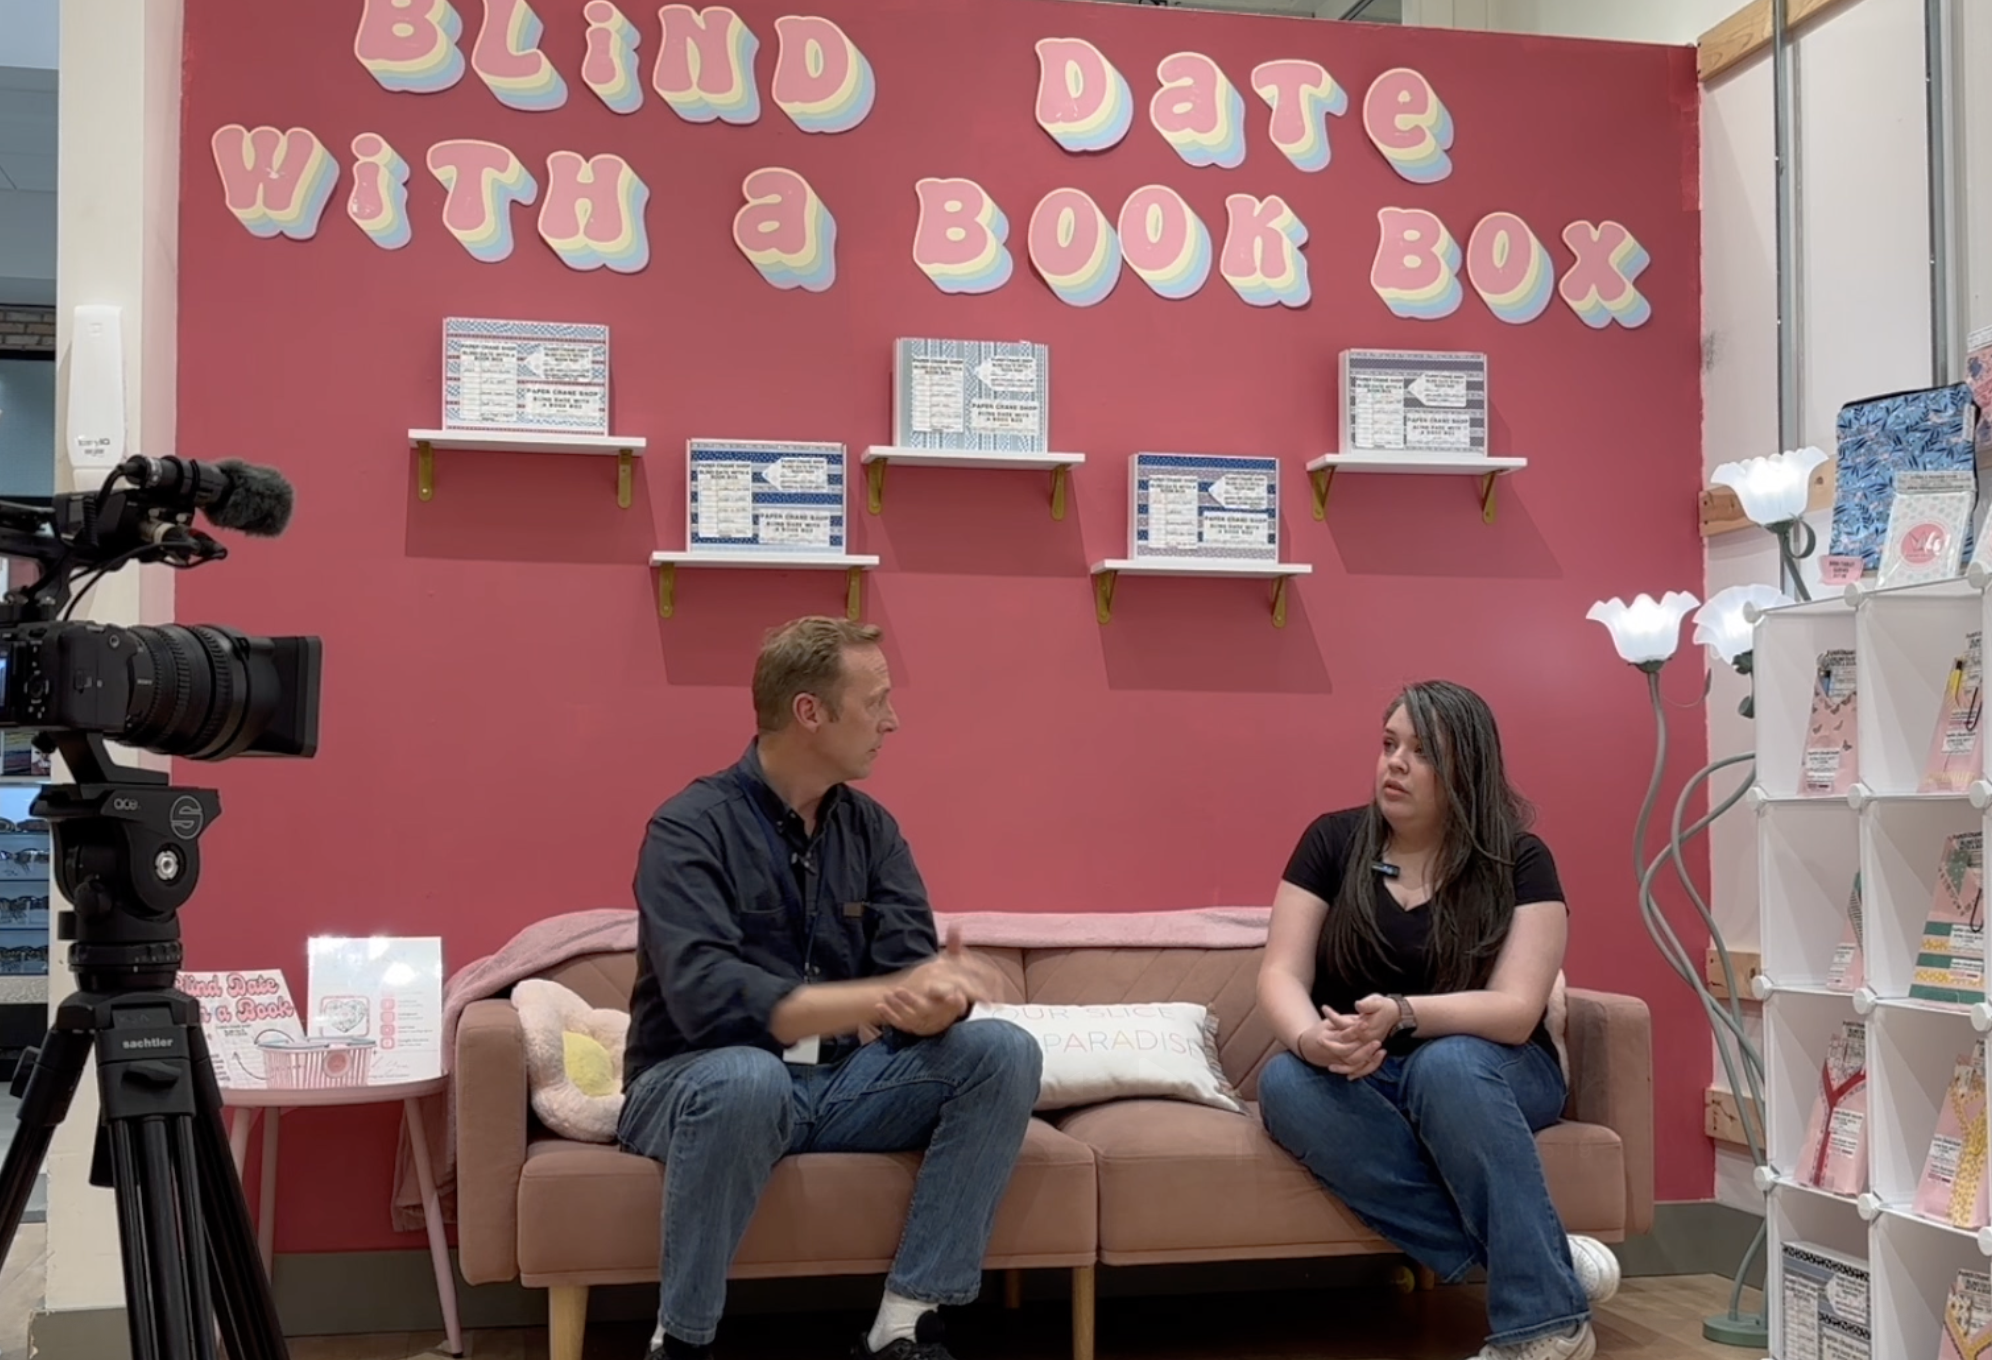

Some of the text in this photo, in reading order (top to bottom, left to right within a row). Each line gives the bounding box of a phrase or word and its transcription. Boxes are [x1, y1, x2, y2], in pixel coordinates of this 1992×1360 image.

[913, 177, 1312, 308] BOOK
[1370, 206, 1651, 329] BOX
[226, 972, 280, 998] Date
[215, 1005, 232, 1023] a
[235, 997, 294, 1023] Book
[1086, 1006, 1176, 1021] SLICE
[122, 1037, 174, 1049] sachtler
